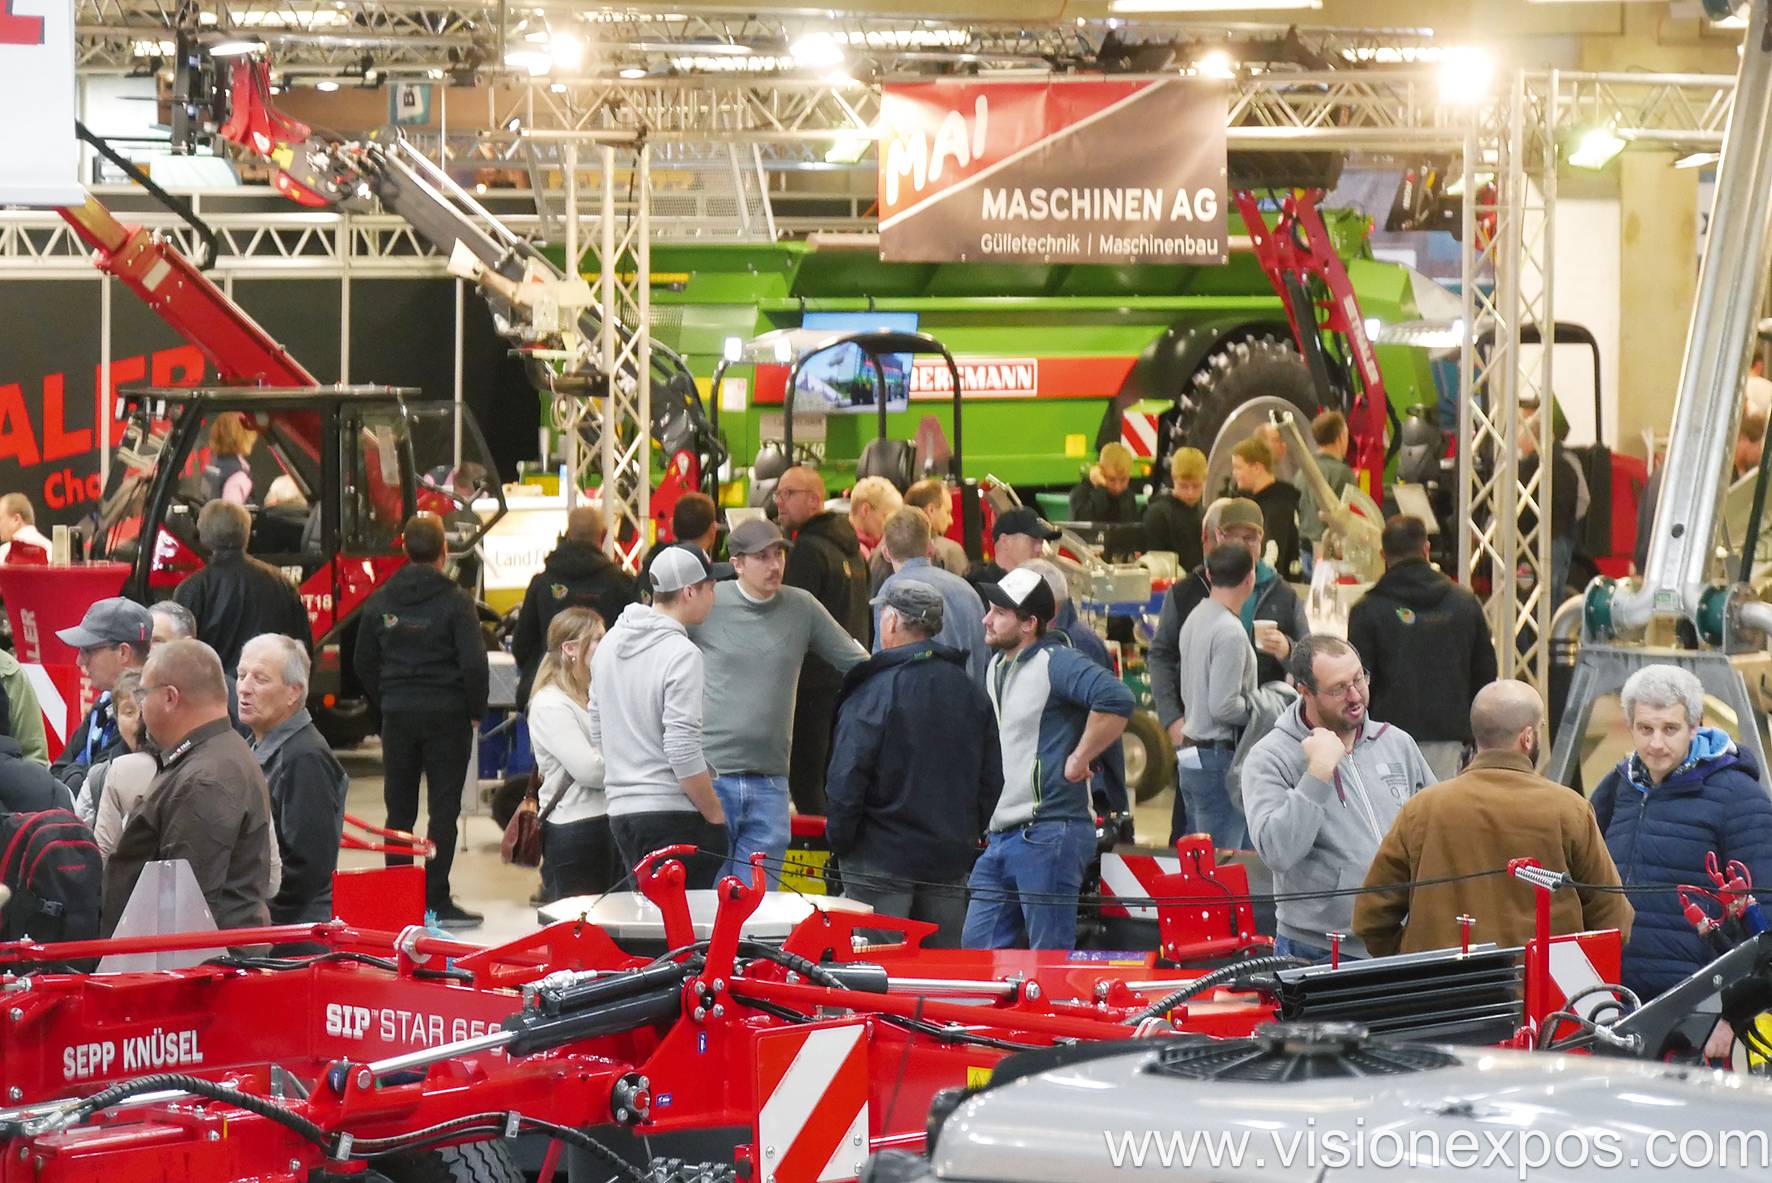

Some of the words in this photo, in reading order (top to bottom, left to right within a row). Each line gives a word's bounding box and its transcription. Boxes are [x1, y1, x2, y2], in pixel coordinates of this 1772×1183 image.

[885, 94, 988, 206] MAI
[981, 187, 1164, 221] MASCHINEN
[1170, 187, 1218, 222] AG
[981, 232, 1080, 255] Gülletechnik
[1099, 233, 1218, 256] Maschinenbau
[326, 1003, 370, 1041] SIP
[380, 1008, 445, 1046] STAR
[63, 1041, 116, 1080] SEPP
[123, 1027, 204, 1072] KNÜSEL
